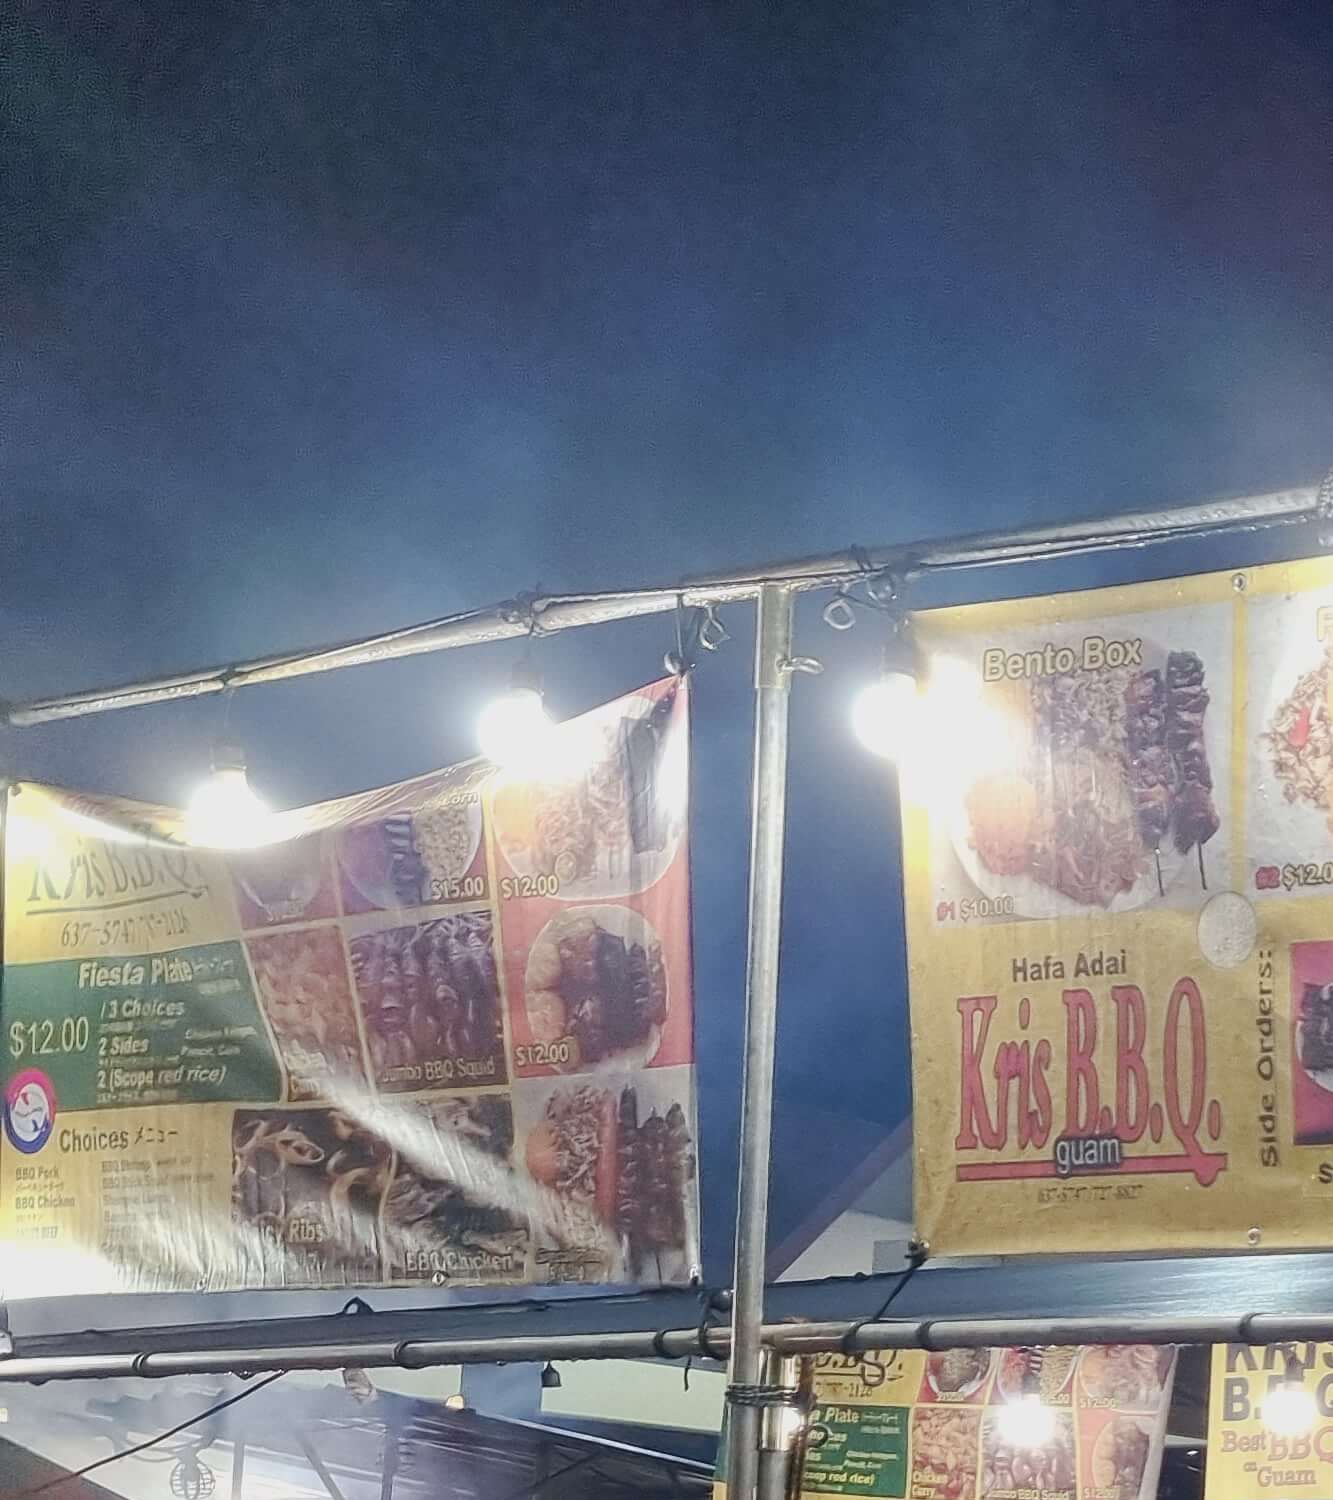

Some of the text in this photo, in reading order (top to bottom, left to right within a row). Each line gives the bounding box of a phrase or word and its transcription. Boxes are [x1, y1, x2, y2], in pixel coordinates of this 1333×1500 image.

[982, 635, 1143, 683] Bento Box
[430, 877, 484, 900] $15.00
[500, 875, 559, 898] $12.00
[960, 895, 1015, 922] $10.00
[79, 961, 146, 989] Fiesta
[151, 957, 194, 985] Plate
[1012, 949, 1128, 982] Hafa Adai
[122, 999, 185, 1018] Choices
[9, 1015, 90, 1059] $12.00
[98, 1033, 150, 1056] 2 Sides
[514, 1043, 569, 1067] $12.00
[1255, 949, 1280, 1170] Side Orders:
[97, 1063, 227, 1089] 2 red rice)
[424, 1057, 496, 1079] BBQ Squid
[955, 995, 1053, 1151] Kris
[59, 1129, 129, 1154] Choices
[1055, 1137, 1122, 1176] guam
[289, 1218, 322, 1240] Ribs
[824, 1406, 860, 1425] Plate
[828, 1471, 849, 1483] red
[1256, 1464, 1318, 1488] Guam
